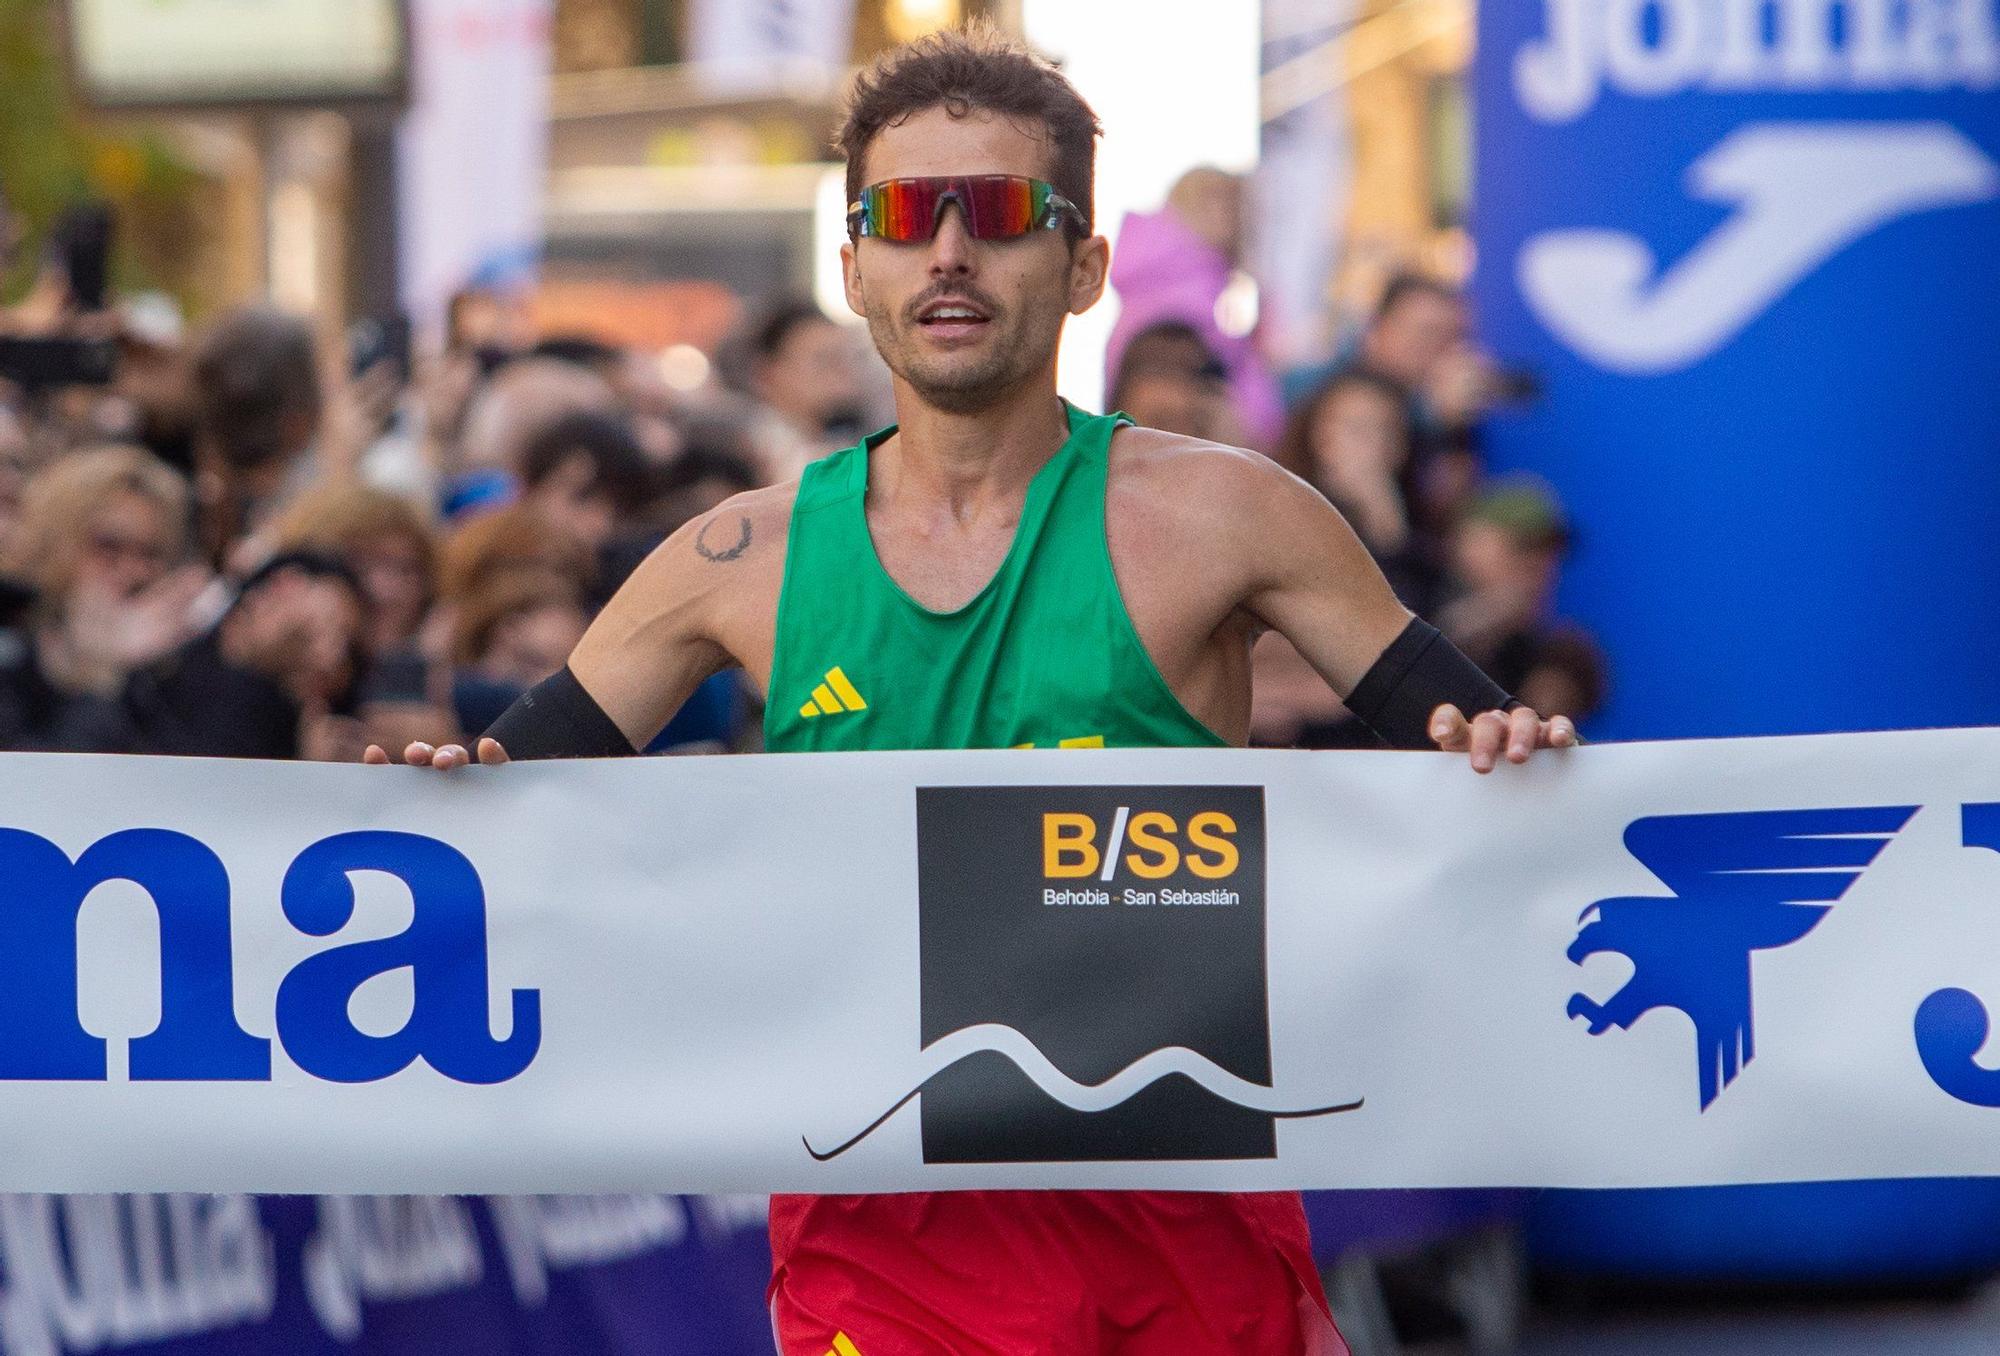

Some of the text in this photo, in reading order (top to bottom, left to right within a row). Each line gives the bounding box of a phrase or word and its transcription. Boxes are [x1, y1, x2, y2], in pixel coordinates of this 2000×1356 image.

[1043, 888, 1110, 905] Behobia
[1123, 888, 1156, 905] San
[1160, 888, 1240, 905] Sebastián
